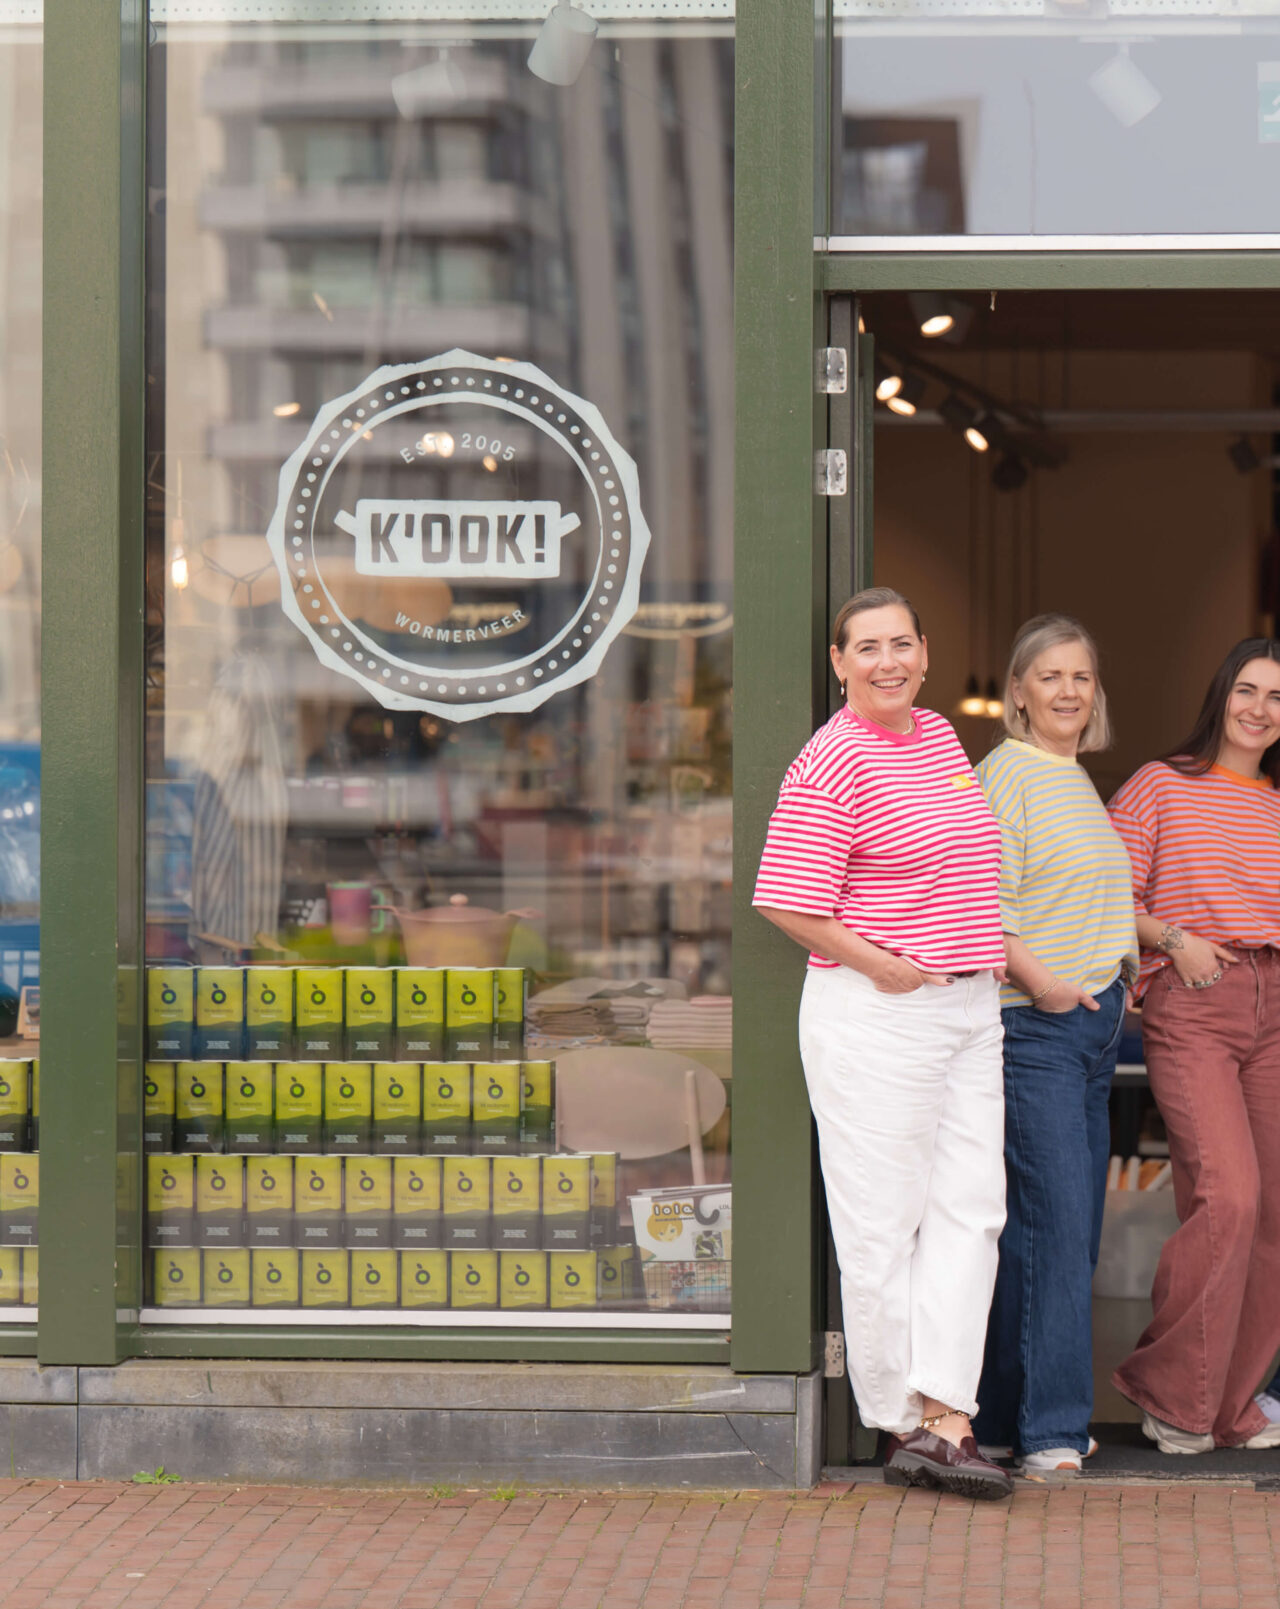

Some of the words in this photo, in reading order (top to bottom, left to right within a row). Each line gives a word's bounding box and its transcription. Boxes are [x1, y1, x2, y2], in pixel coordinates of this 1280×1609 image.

[461, 433, 516, 461] 2005
[370, 512, 546, 564] K'OOK!
[395, 609, 526, 643] WORMERVEER
